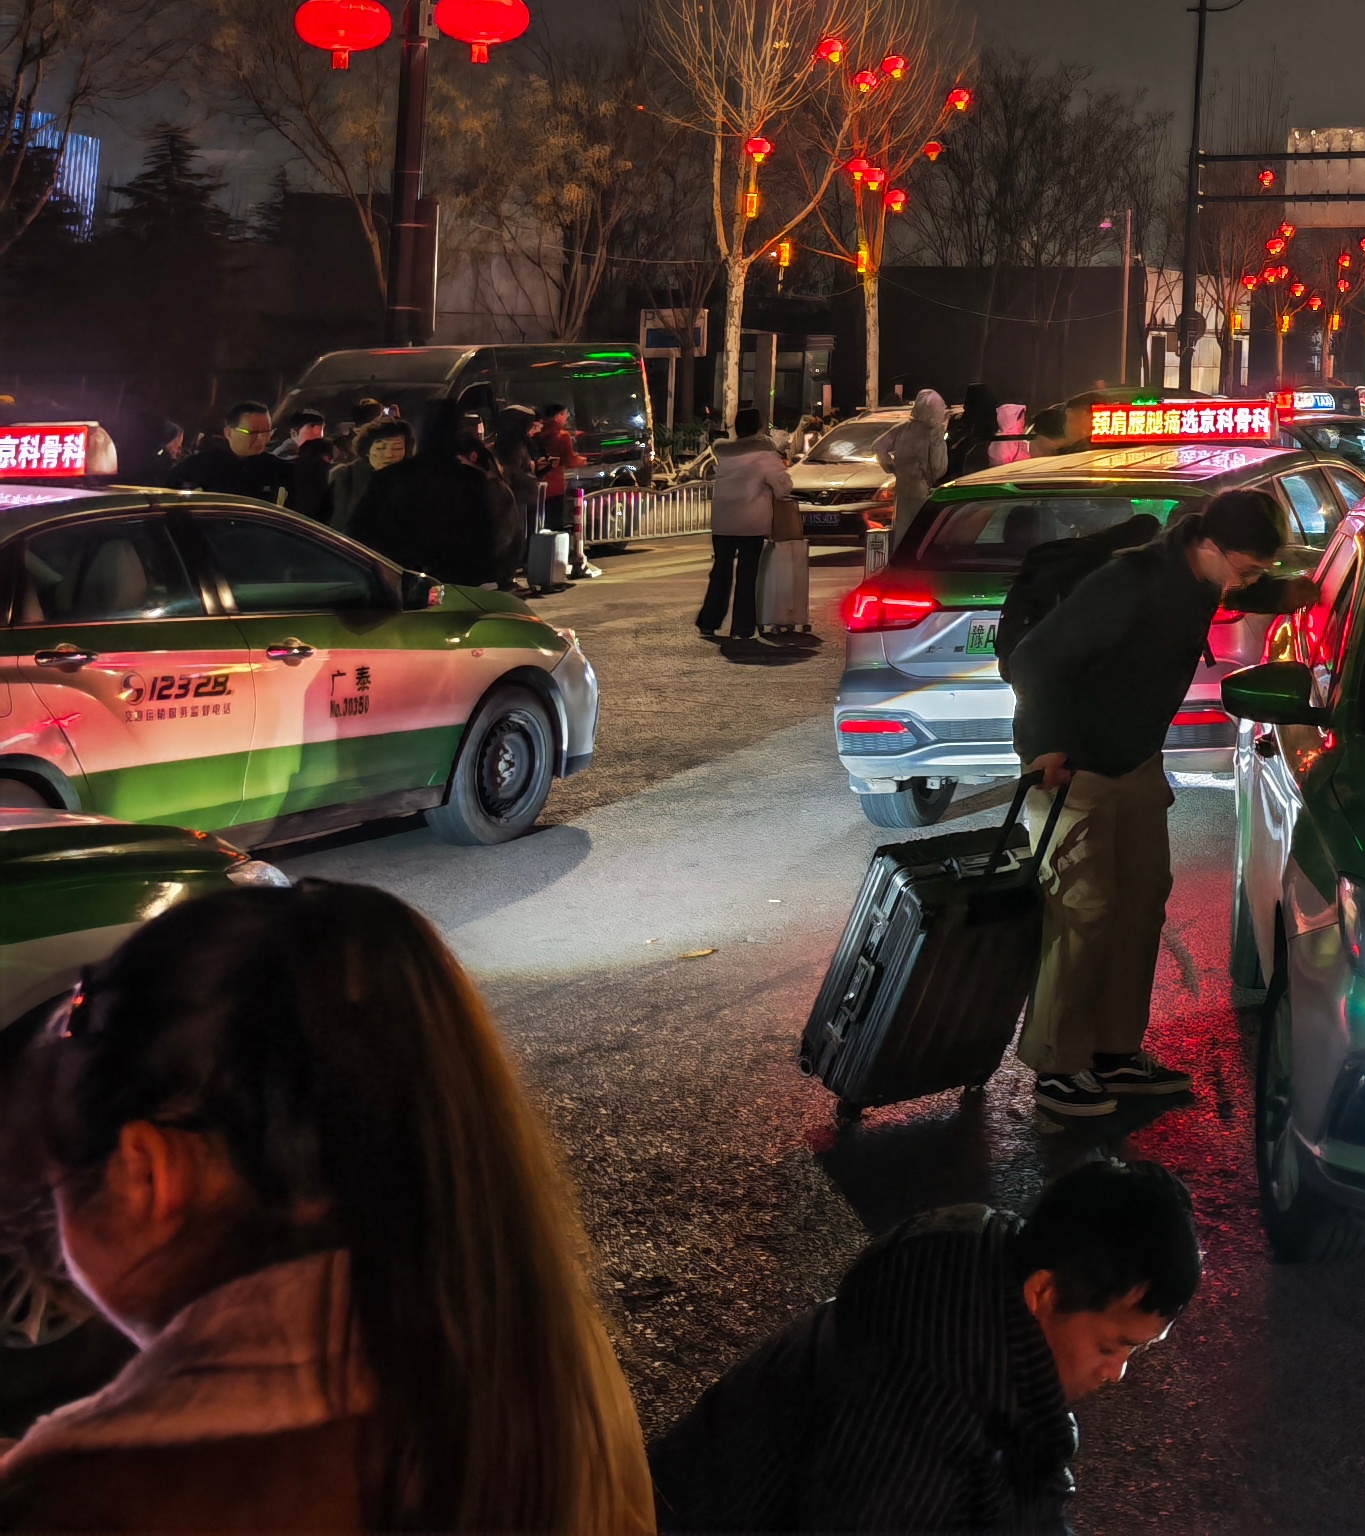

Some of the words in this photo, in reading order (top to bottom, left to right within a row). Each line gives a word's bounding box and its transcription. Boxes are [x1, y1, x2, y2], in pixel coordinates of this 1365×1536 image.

[1092, 408, 1271, 436] 颈肩腰腿痛选京科骨科
[148, 673, 230, 701] 12328
[331, 666, 371, 696] 广泰
